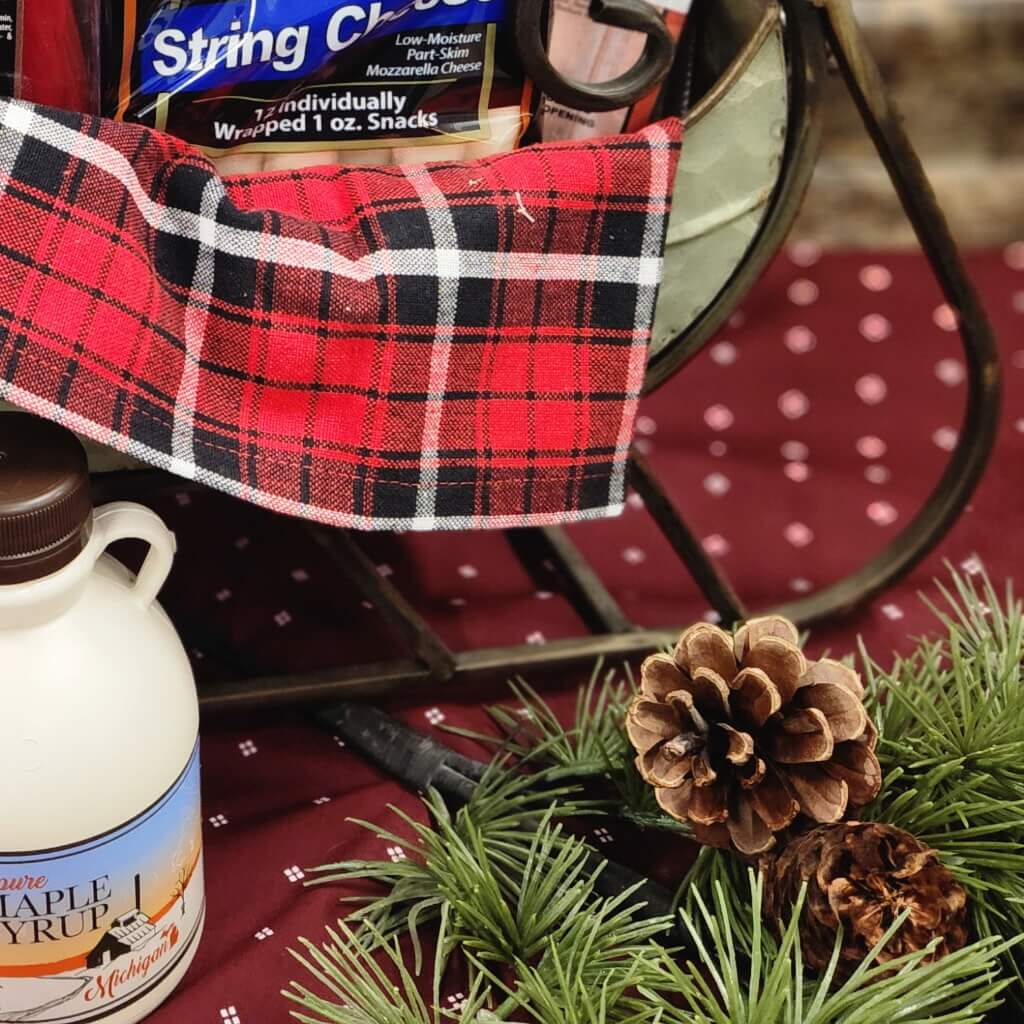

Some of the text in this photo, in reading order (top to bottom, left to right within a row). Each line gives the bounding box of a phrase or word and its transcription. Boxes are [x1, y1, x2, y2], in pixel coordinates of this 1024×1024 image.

[152, 19, 310, 78] String
[395, 31, 483, 47] Low-Moisture
[406, 47, 470, 62] Part-Skim
[366, 60, 483, 78] Mozzarella Cheese
[278, 90, 407, 115] Individually
[213, 109, 439, 142] Wrapped 1 oz. Snacks
[84, 940, 171, 1002] Michigan
